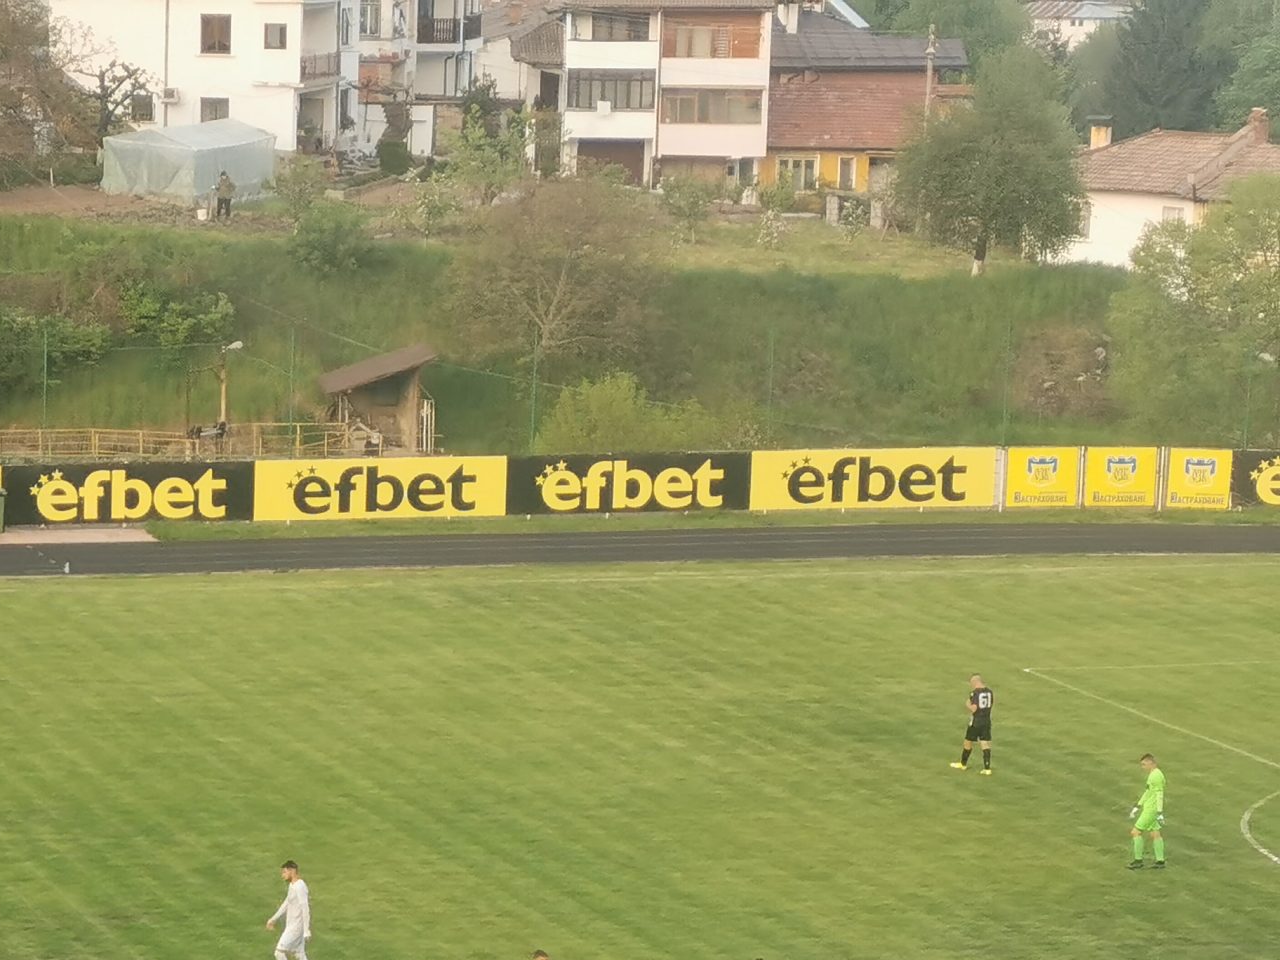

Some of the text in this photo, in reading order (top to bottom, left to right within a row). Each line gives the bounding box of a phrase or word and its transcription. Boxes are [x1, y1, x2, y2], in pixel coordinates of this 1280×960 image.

[36, 469, 227, 522] efbet
[294, 464, 477, 514] efbet
[541, 460, 725, 511] efbet
[787, 456, 967, 503] efbet
[978, 691, 992, 709] 61
